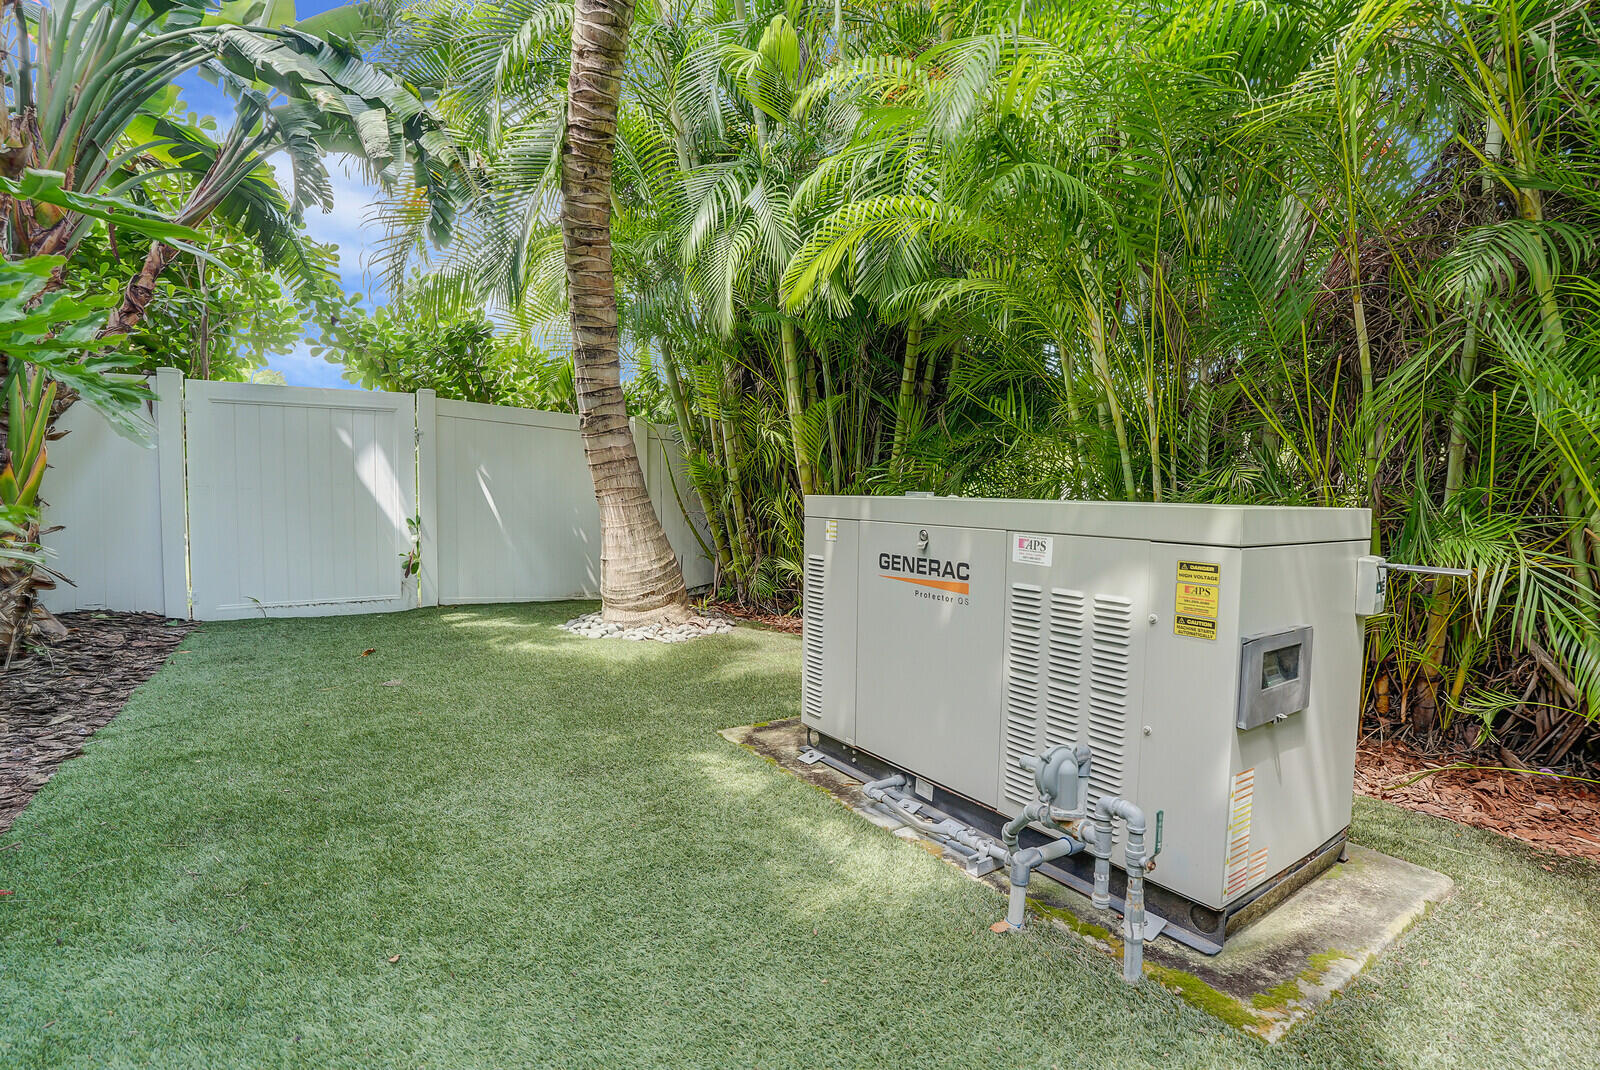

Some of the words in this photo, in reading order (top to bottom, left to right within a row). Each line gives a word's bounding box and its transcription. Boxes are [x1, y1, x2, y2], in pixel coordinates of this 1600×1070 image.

[879, 553, 970, 580] GENERAC
[914, 590, 953, 603] Protector
[1186, 619, 1213, 628] CAUTION
